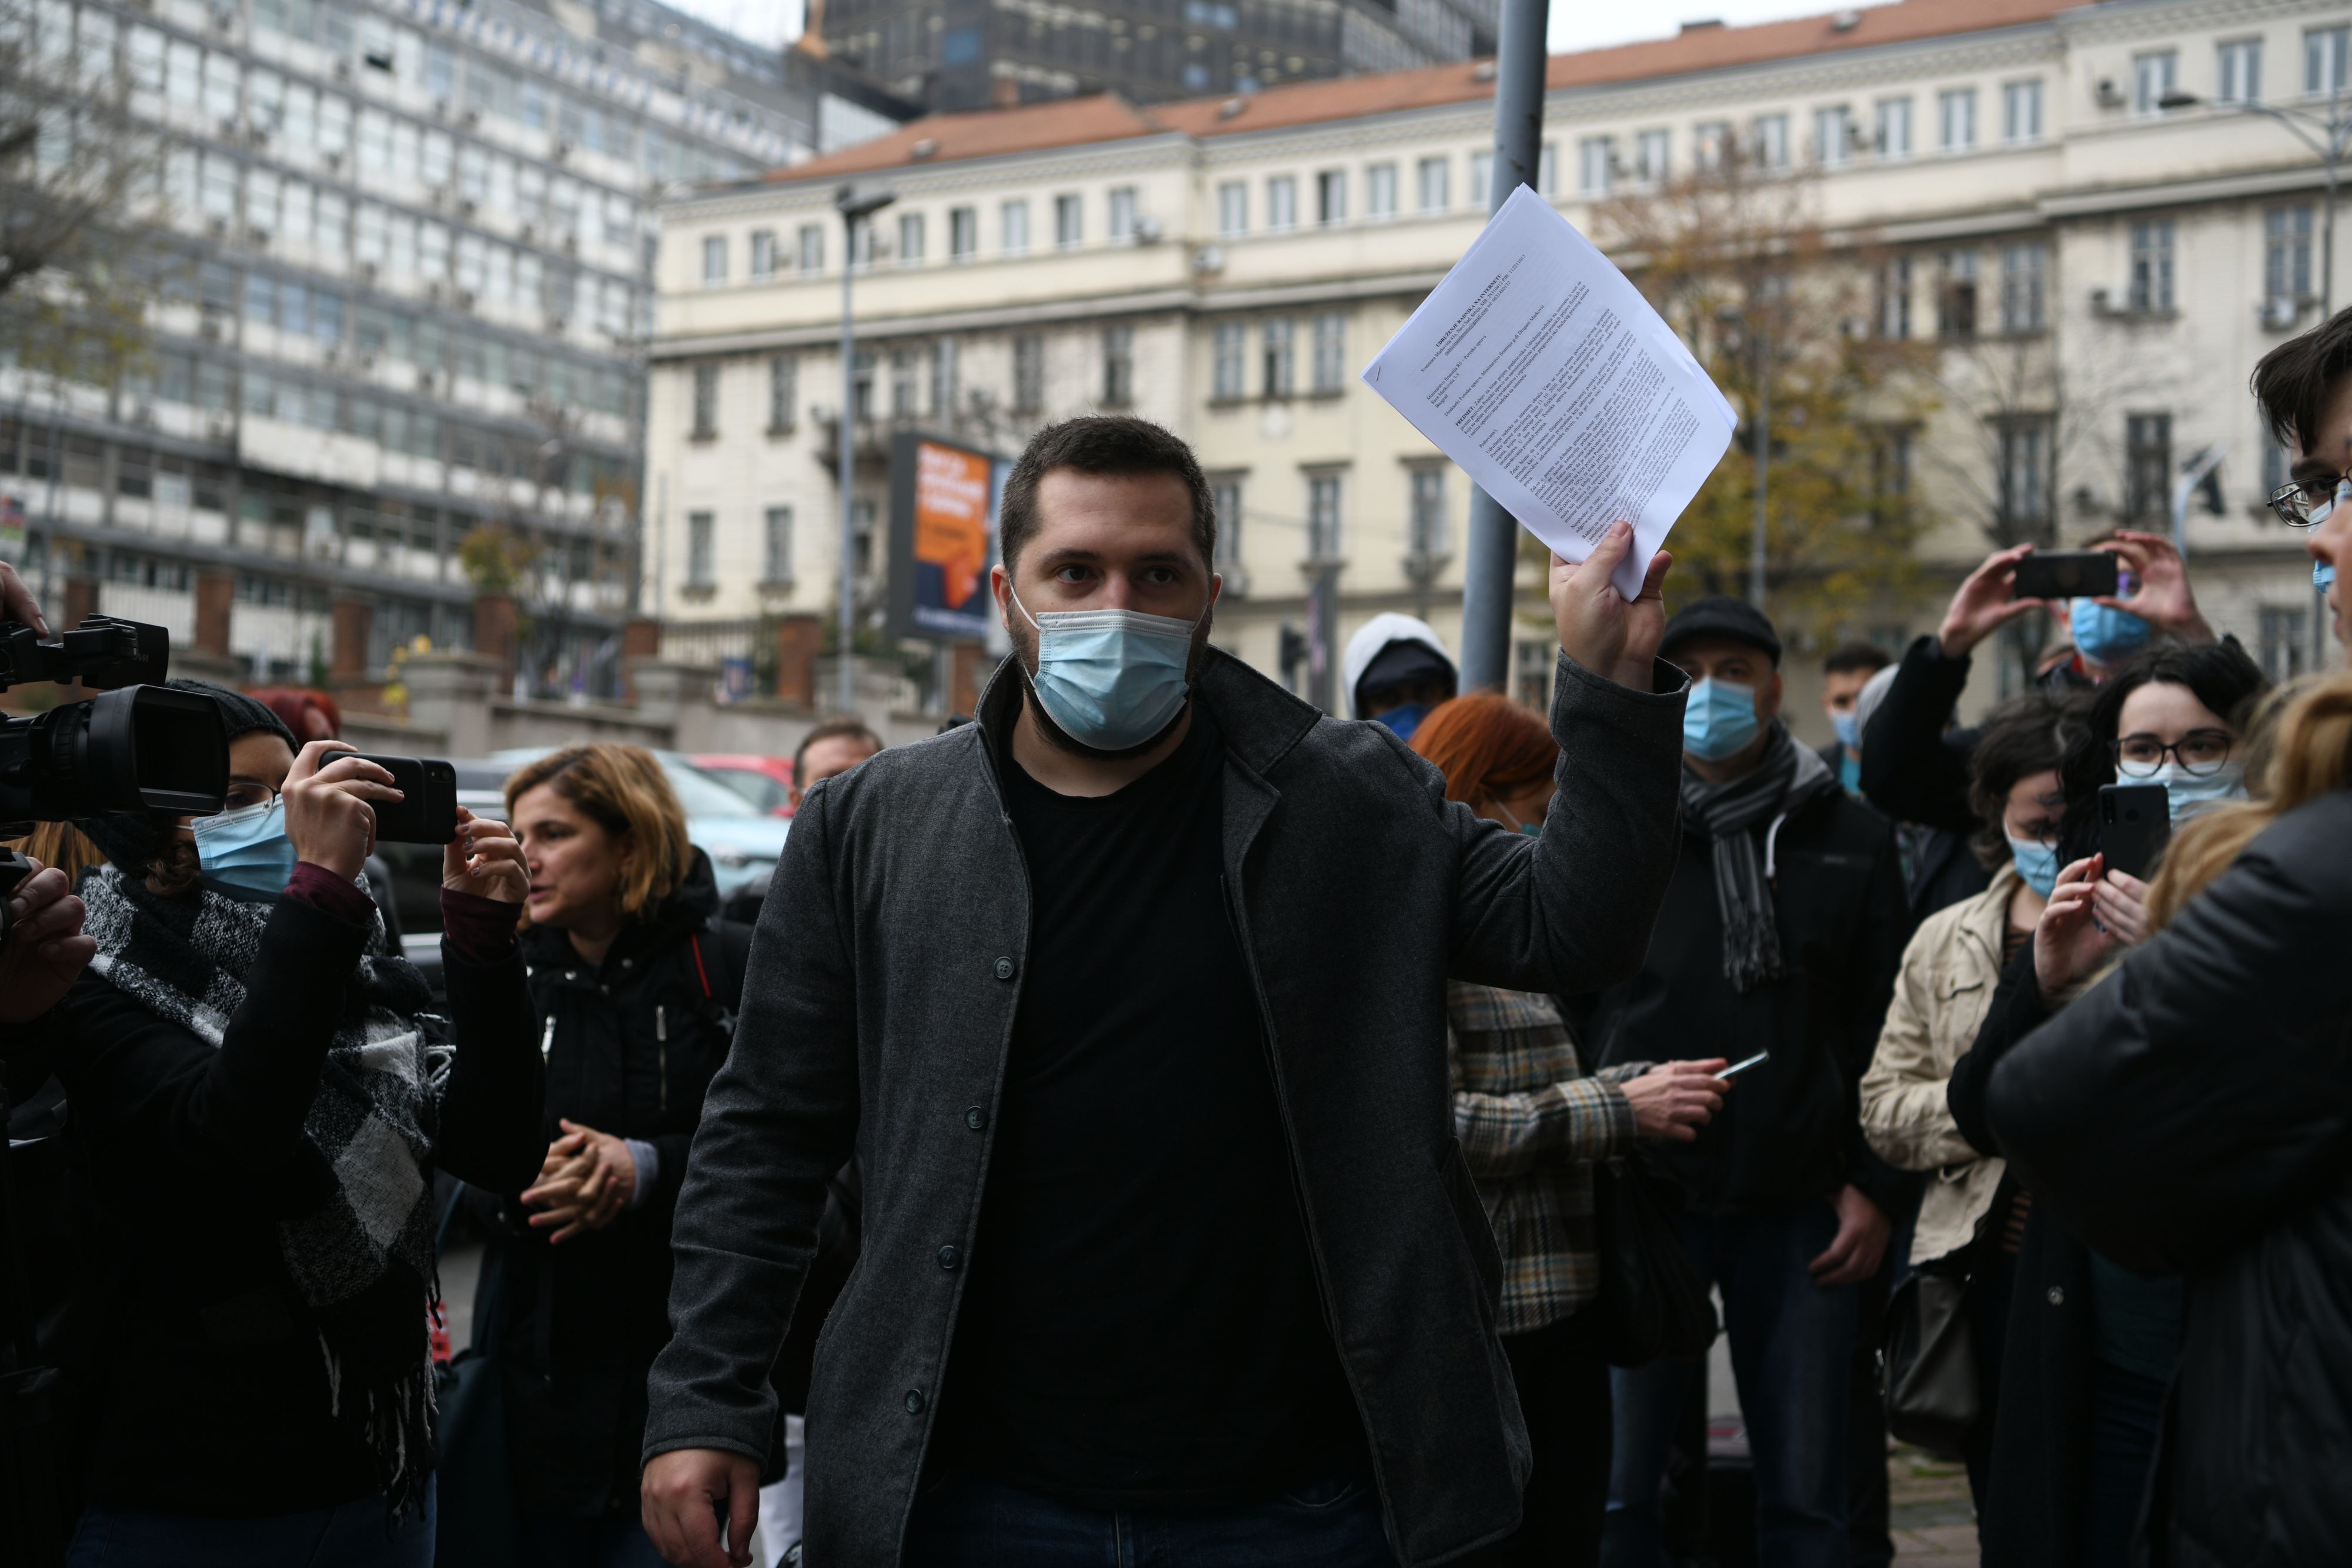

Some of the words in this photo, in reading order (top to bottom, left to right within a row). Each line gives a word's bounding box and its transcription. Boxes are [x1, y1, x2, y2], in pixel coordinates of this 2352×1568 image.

[1420, 355, 1436, 373] Svetozara
[1434, 339, 1451, 357] Markovića
[1449, 332, 1458, 340] 43a,
[1455, 323, 1465, 333] Novi
[1463, 316, 1472, 325] Sad,
[1470, 305, 1482, 318] Srbija,
[1479, 297, 1488, 306] MB:
[1501, 272, 1510, 282] PIB:
[1435, 322, 1458, 347] UDRUŽENJE
[1456, 304, 1475, 323] RADNIKA
[1479, 273, 1501, 299] INTERNETU
[1426, 379, 1445, 400] Ministarstvo
[1443, 366, 1458, 382] finansija
[1463, 345, 1476, 359] Poreska
[1475, 335, 1487, 347] uprava
[1444, 399, 1461, 417] Direktorki
[1458, 386, 1472, 400] Poreske
[1470, 376, 1483, 389] uprave,
[1480, 355, 1500, 376] Ministarstvo
[1498, 340, 1514, 357] finansija
[1517, 320, 1532, 336] Dragani
[1529, 303, 1545, 322] Marković
[1434, 393, 1449, 409] Beograd
